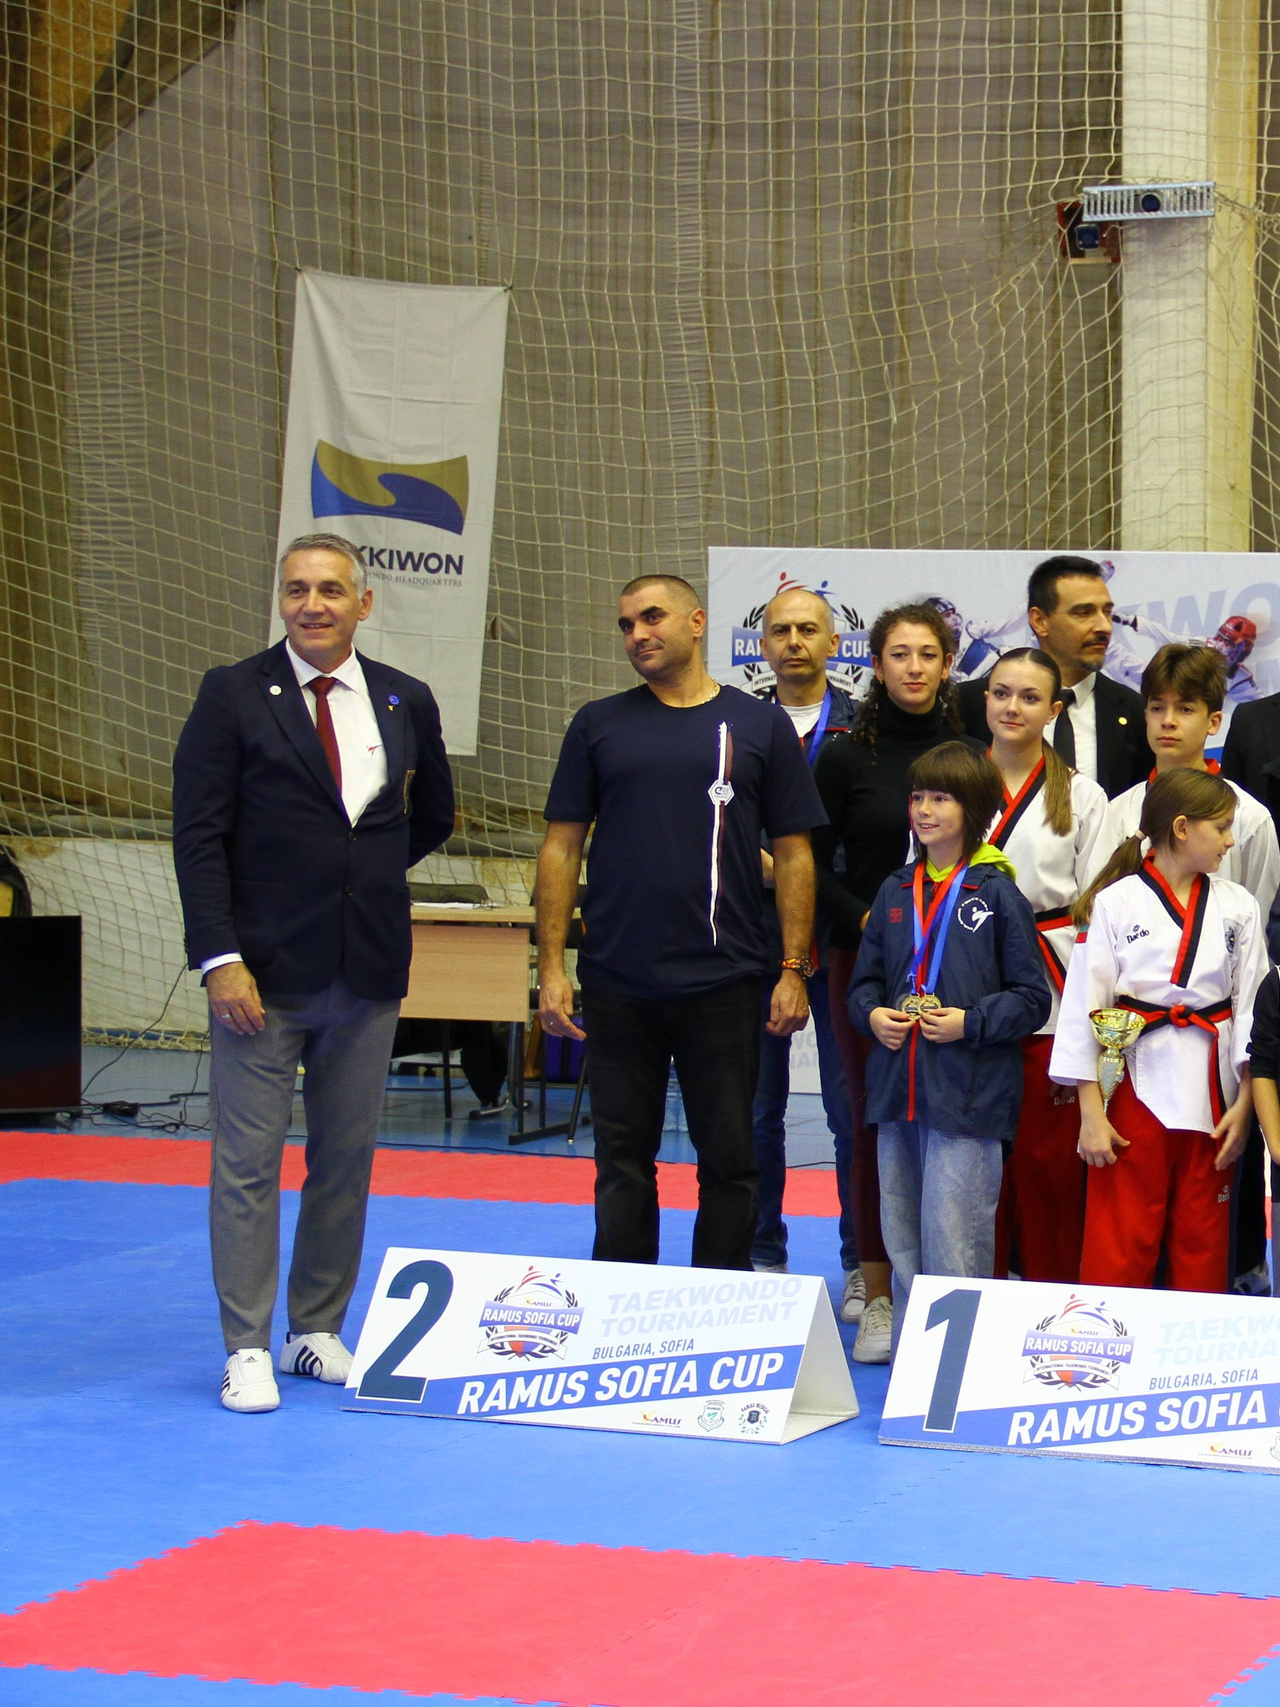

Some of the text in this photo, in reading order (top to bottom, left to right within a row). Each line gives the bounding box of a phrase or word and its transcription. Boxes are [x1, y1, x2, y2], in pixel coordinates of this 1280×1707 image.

[359, 546, 464, 575] KIWON
[395, 575, 462, 587] HEADQUARTERS
[608, 1277, 803, 1314] TAEKWONDO
[357, 1259, 454, 1401] 2
[482, 1308, 581, 1328] RAMUS SOFIA CUP
[601, 1301, 798, 1337] TOURNAMENT
[592, 1338, 695, 1360] BULGARIA, SOFIA
[924, 1289, 982, 1432] 1
[1025, 1337, 1132, 1357] RAMUS SOFIA CUP
[457, 1352, 784, 1415] RAMUS SOFIA CUP
[1149, 1368, 1258, 1390] BULGARIA, SOFIA
[1007, 1401, 1149, 1446] RAMUS
[1155, 1391, 1266, 1432] SOFIA
